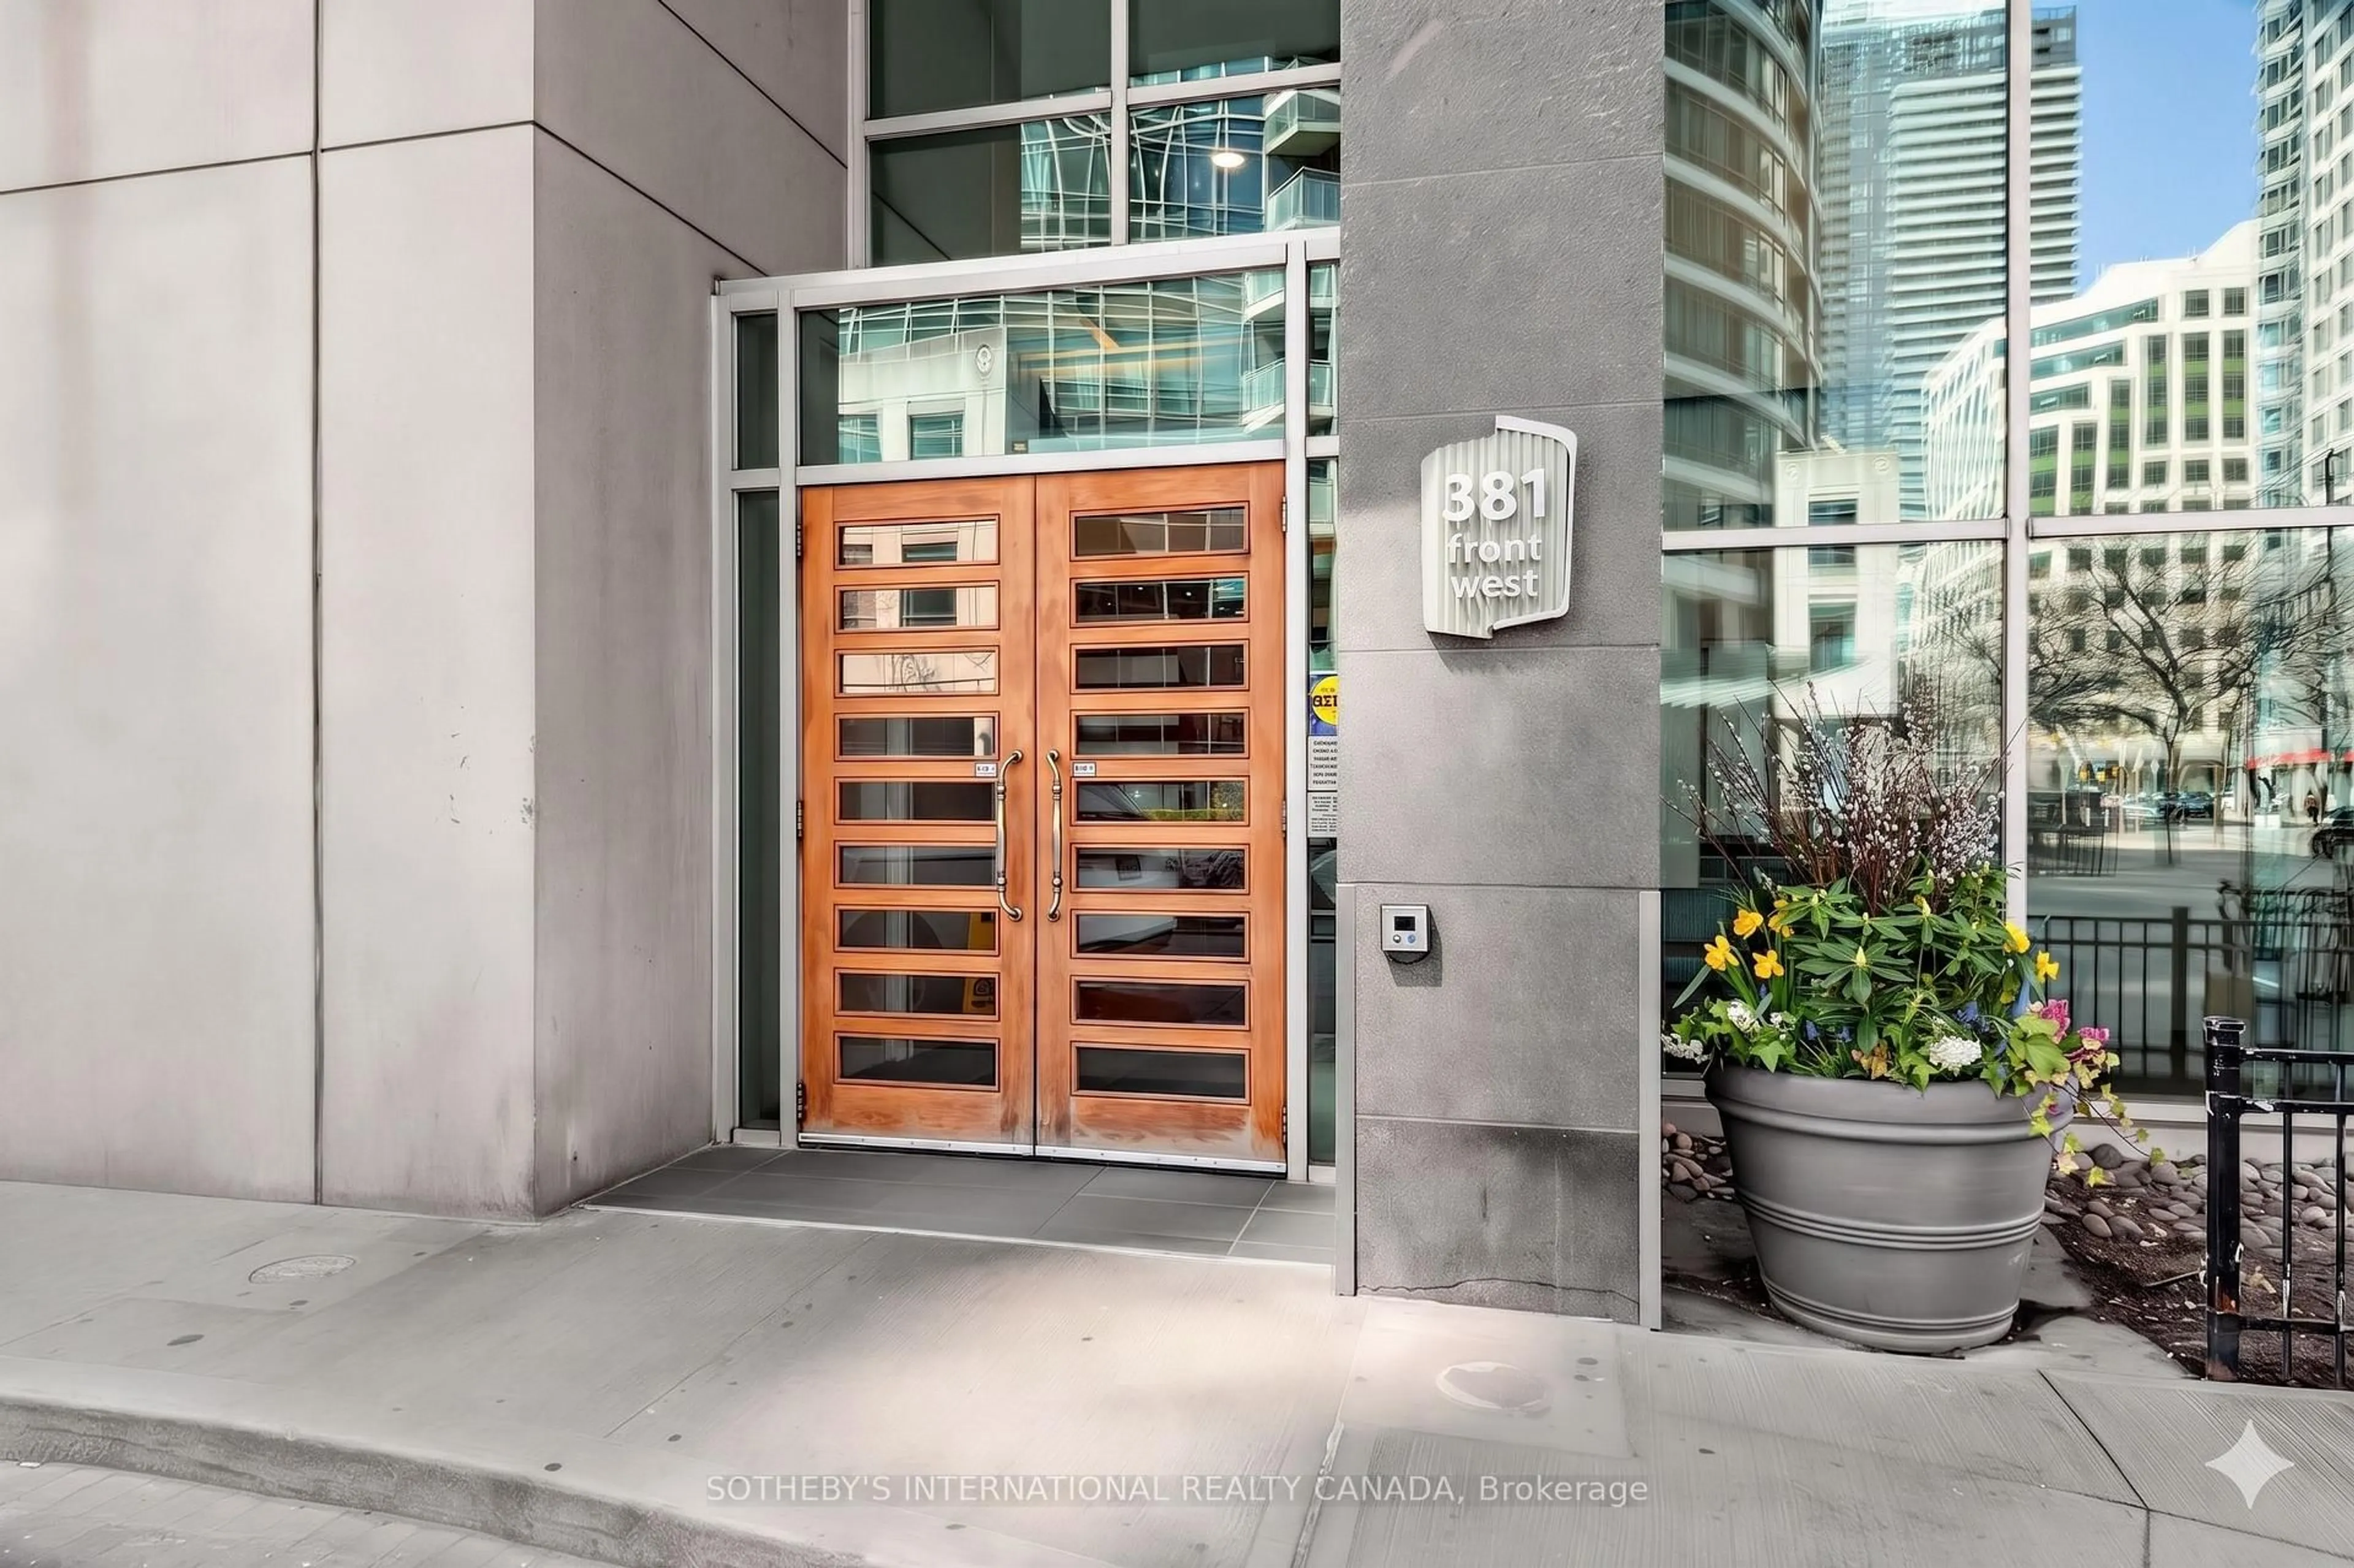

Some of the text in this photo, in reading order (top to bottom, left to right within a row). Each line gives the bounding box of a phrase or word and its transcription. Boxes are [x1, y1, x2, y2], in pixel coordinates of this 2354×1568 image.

[1442, 468, 1545, 522] 381
[1447, 533, 1542, 563] front
[1450, 569, 1539, 598] west
